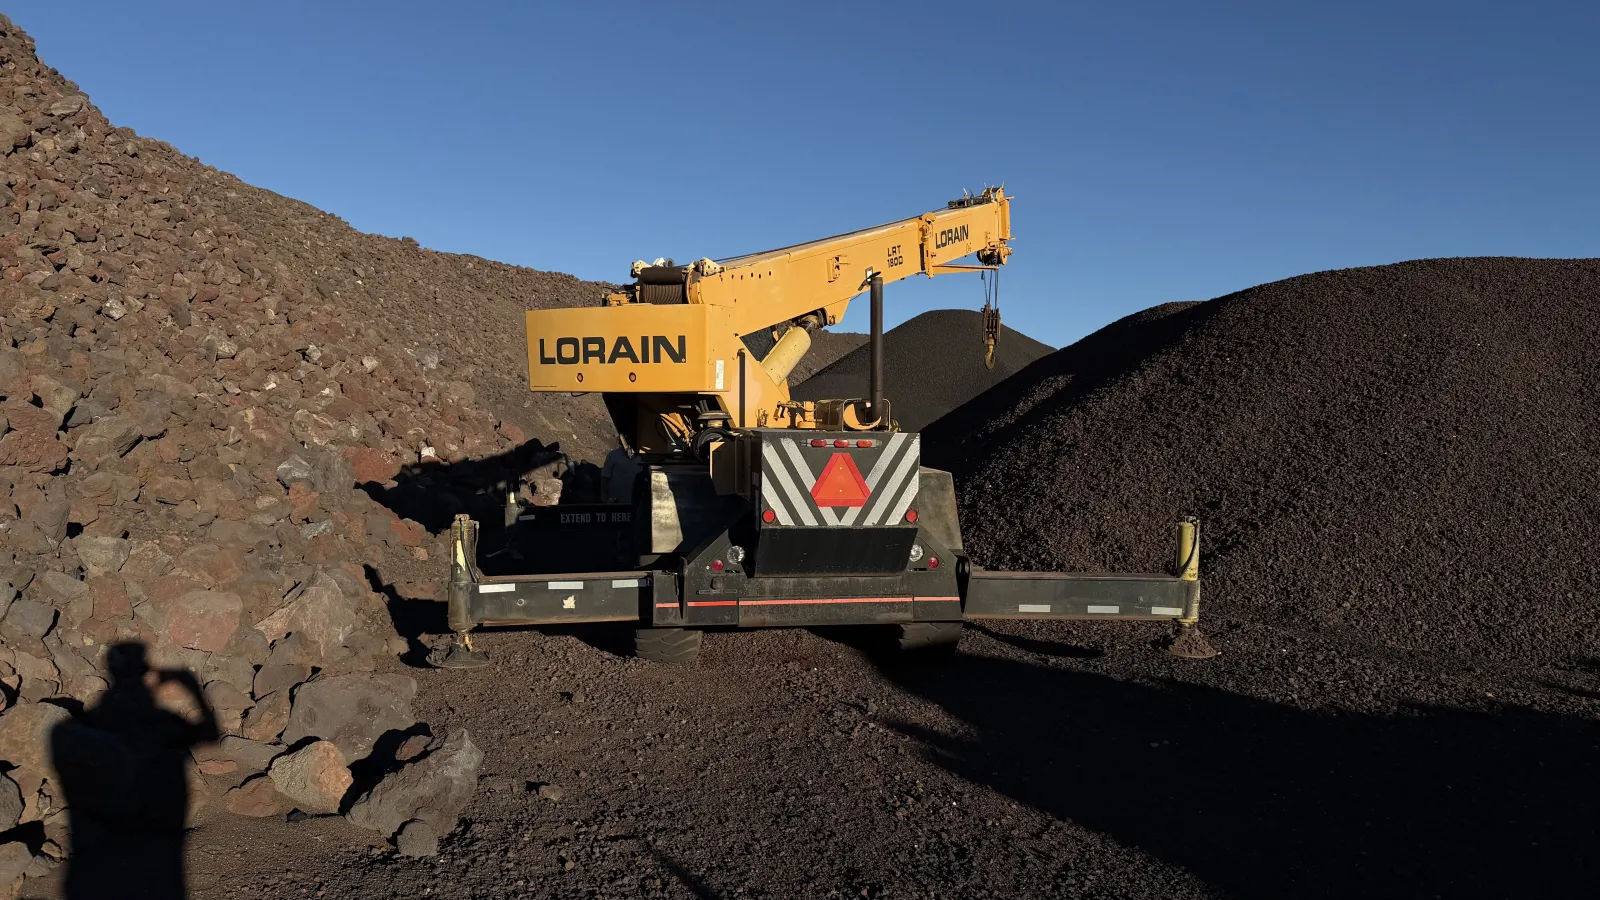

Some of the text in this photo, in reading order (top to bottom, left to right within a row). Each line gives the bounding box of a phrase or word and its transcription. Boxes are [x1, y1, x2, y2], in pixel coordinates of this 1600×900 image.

[935, 224, 969, 249] LORAIN
[887, 245, 901, 257] LRT
[539, 336, 686, 364] LORAIN
[560, 512, 631, 523] EXTEND TO HERE
